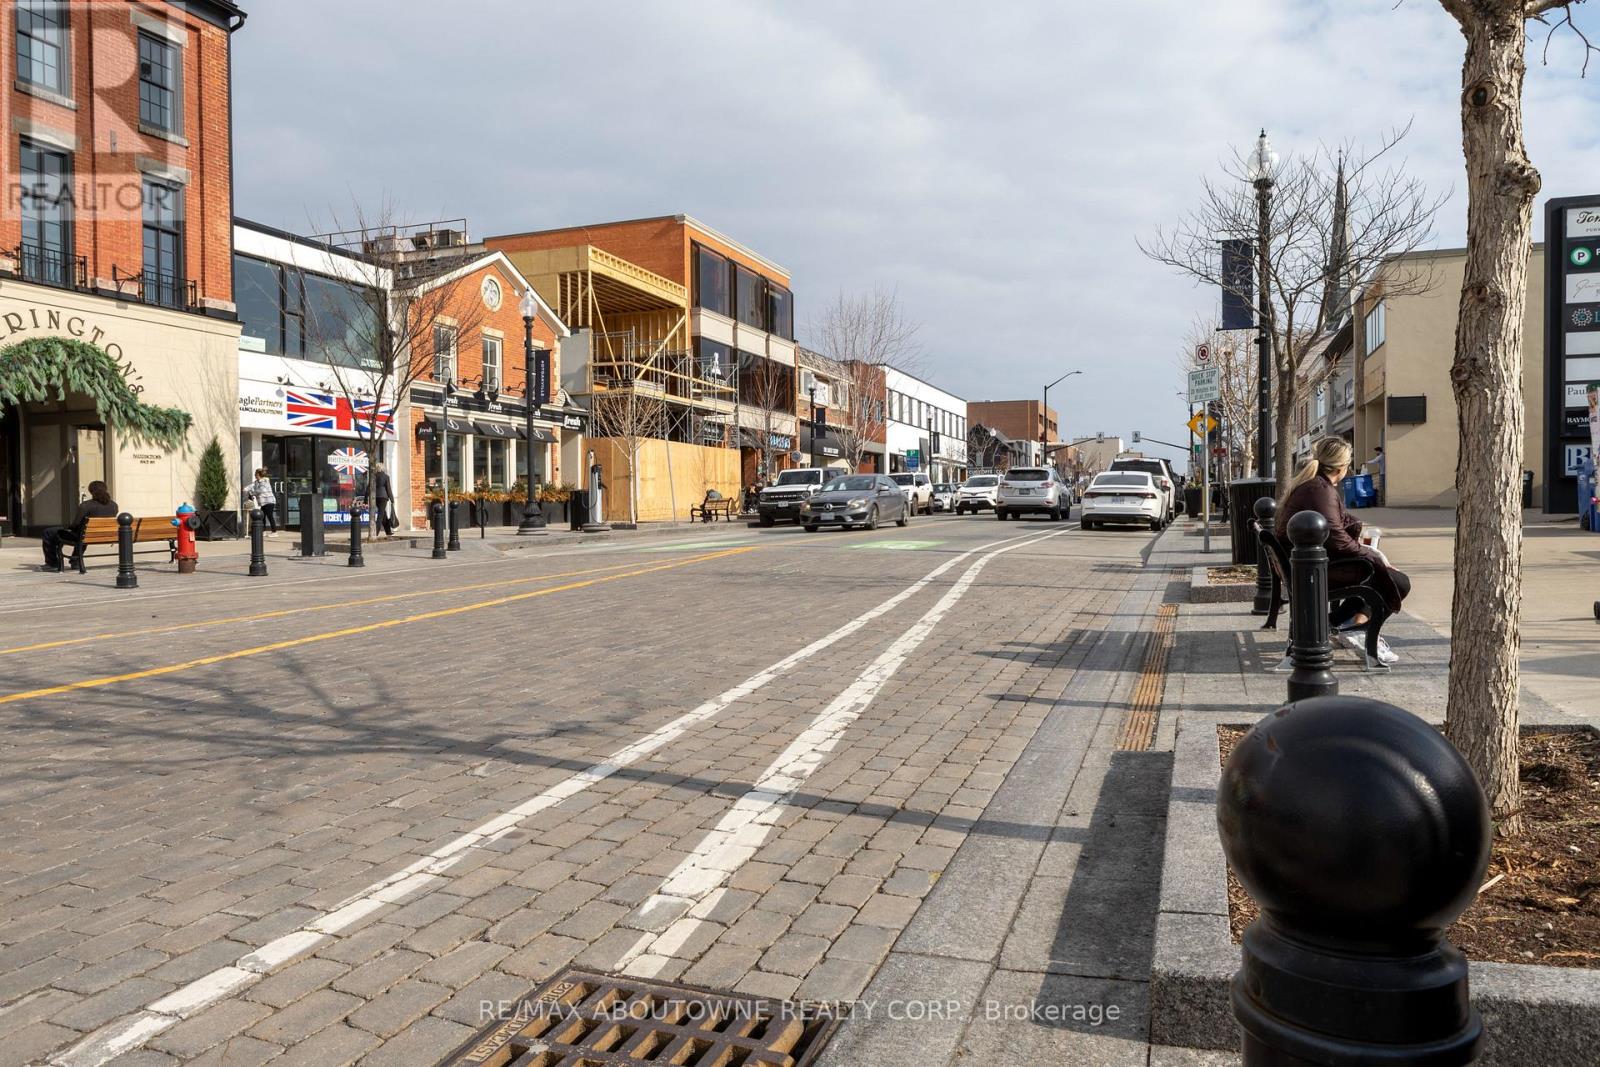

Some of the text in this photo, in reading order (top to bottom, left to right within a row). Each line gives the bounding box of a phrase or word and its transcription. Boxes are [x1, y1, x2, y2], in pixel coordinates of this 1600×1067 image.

[1577, 252, 1585, 261] P
[0, 309, 144, 395] RINGTON'S
[1206, 370, 1216, 378] STOP
[1195, 378, 1212, 386] PARKING
[239, 396, 283, 408] aglePartners
[488, 401, 503, 412] fresh
[564, 414, 581, 427] fresh
[1567, 416, 1587, 424] RAYMO
[541, 982, 571, 1002] 2018
